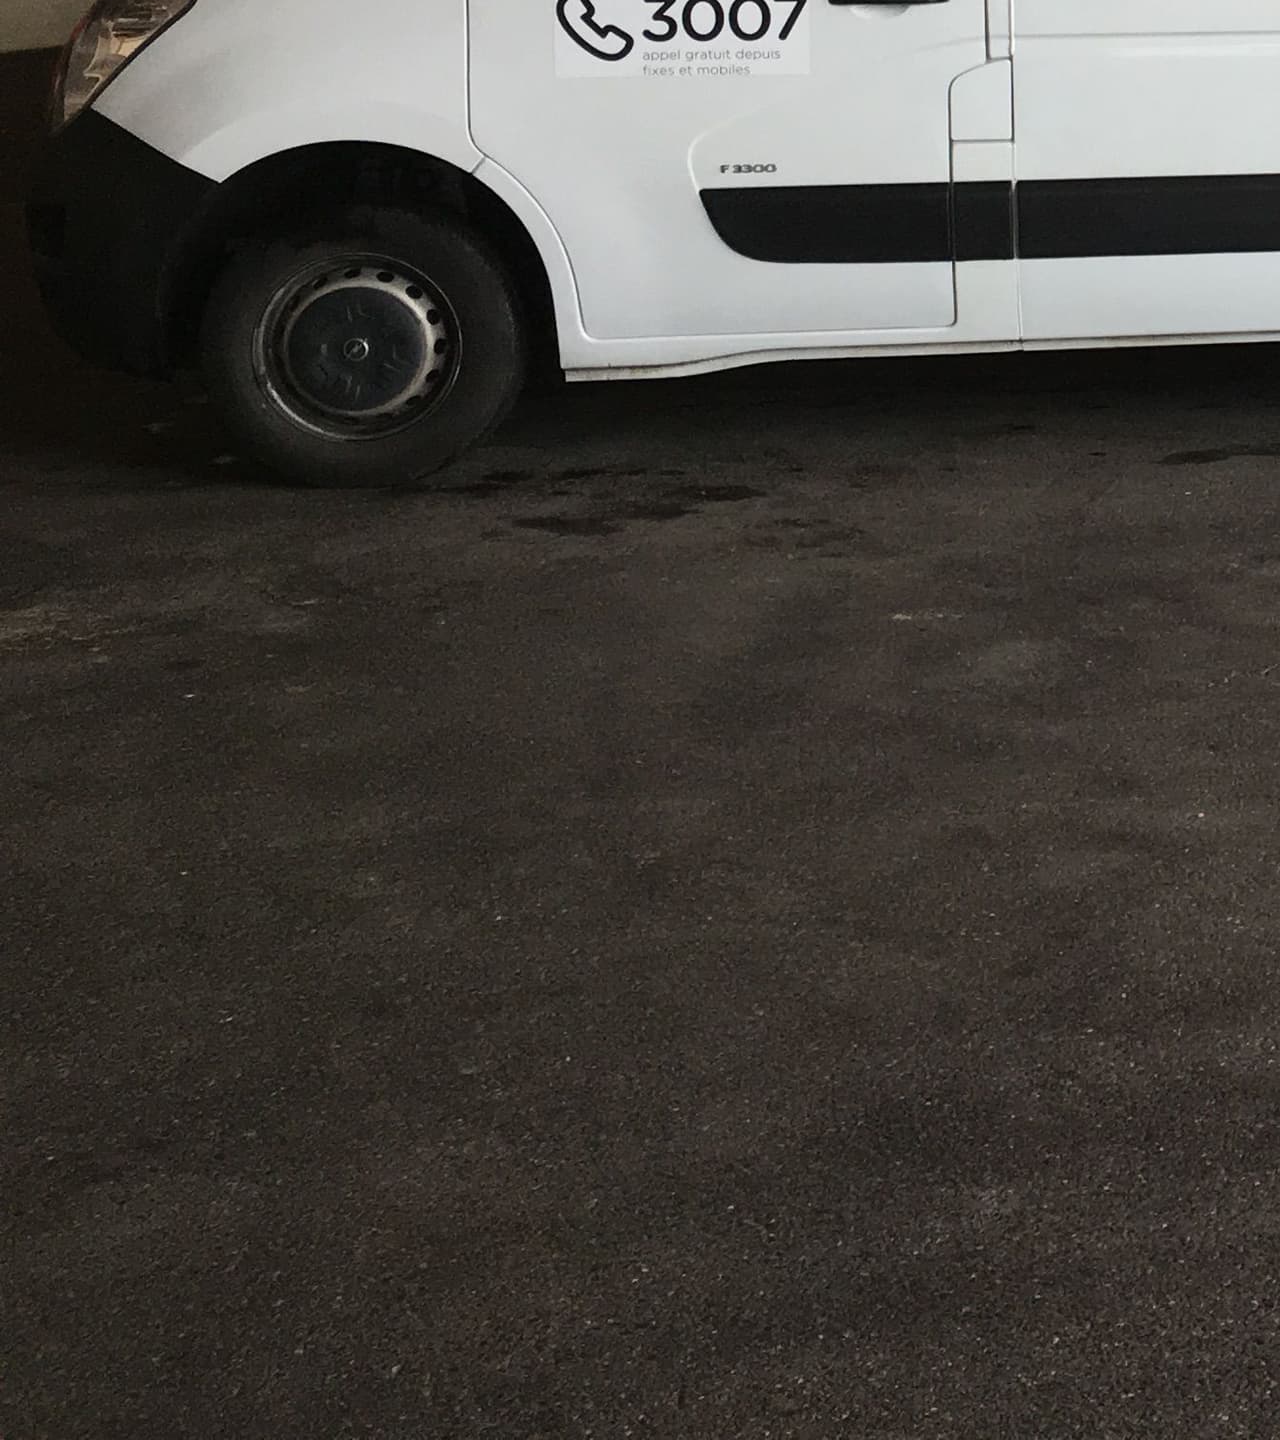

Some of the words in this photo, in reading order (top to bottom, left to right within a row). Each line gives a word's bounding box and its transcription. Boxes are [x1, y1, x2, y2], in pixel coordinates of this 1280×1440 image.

[642, 49, 681, 62] appel
[685, 48, 731, 62] gratuit
[735, 48, 782, 60] depuis
[642, 65, 675, 76] fixes
[679, 65, 693, 76] et
[696, 64, 751, 76] mobiles
[720, 164, 729, 174] F
[732, 163, 778, 174] 3300
